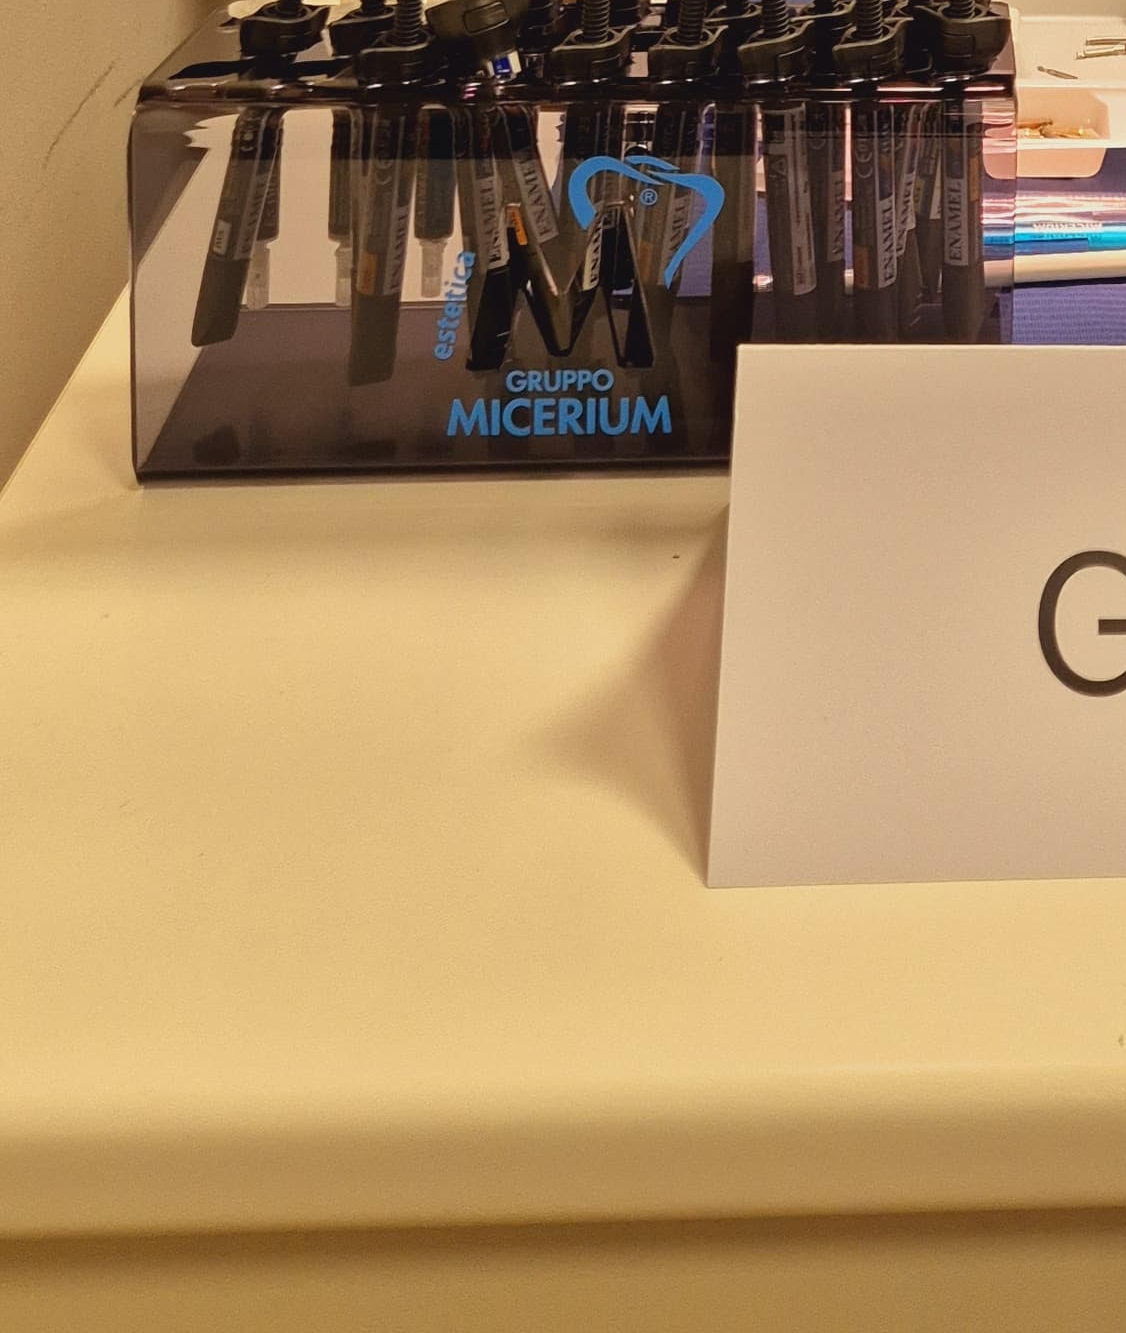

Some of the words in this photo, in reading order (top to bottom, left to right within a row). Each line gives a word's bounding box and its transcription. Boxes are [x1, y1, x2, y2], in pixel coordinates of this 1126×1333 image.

[949, 181, 963, 263] ENAMEL
[434, 250, 475, 361] estetica
[505, 368, 615, 393] GRUPPO
[446, 394, 673, 438] MICERIUM
